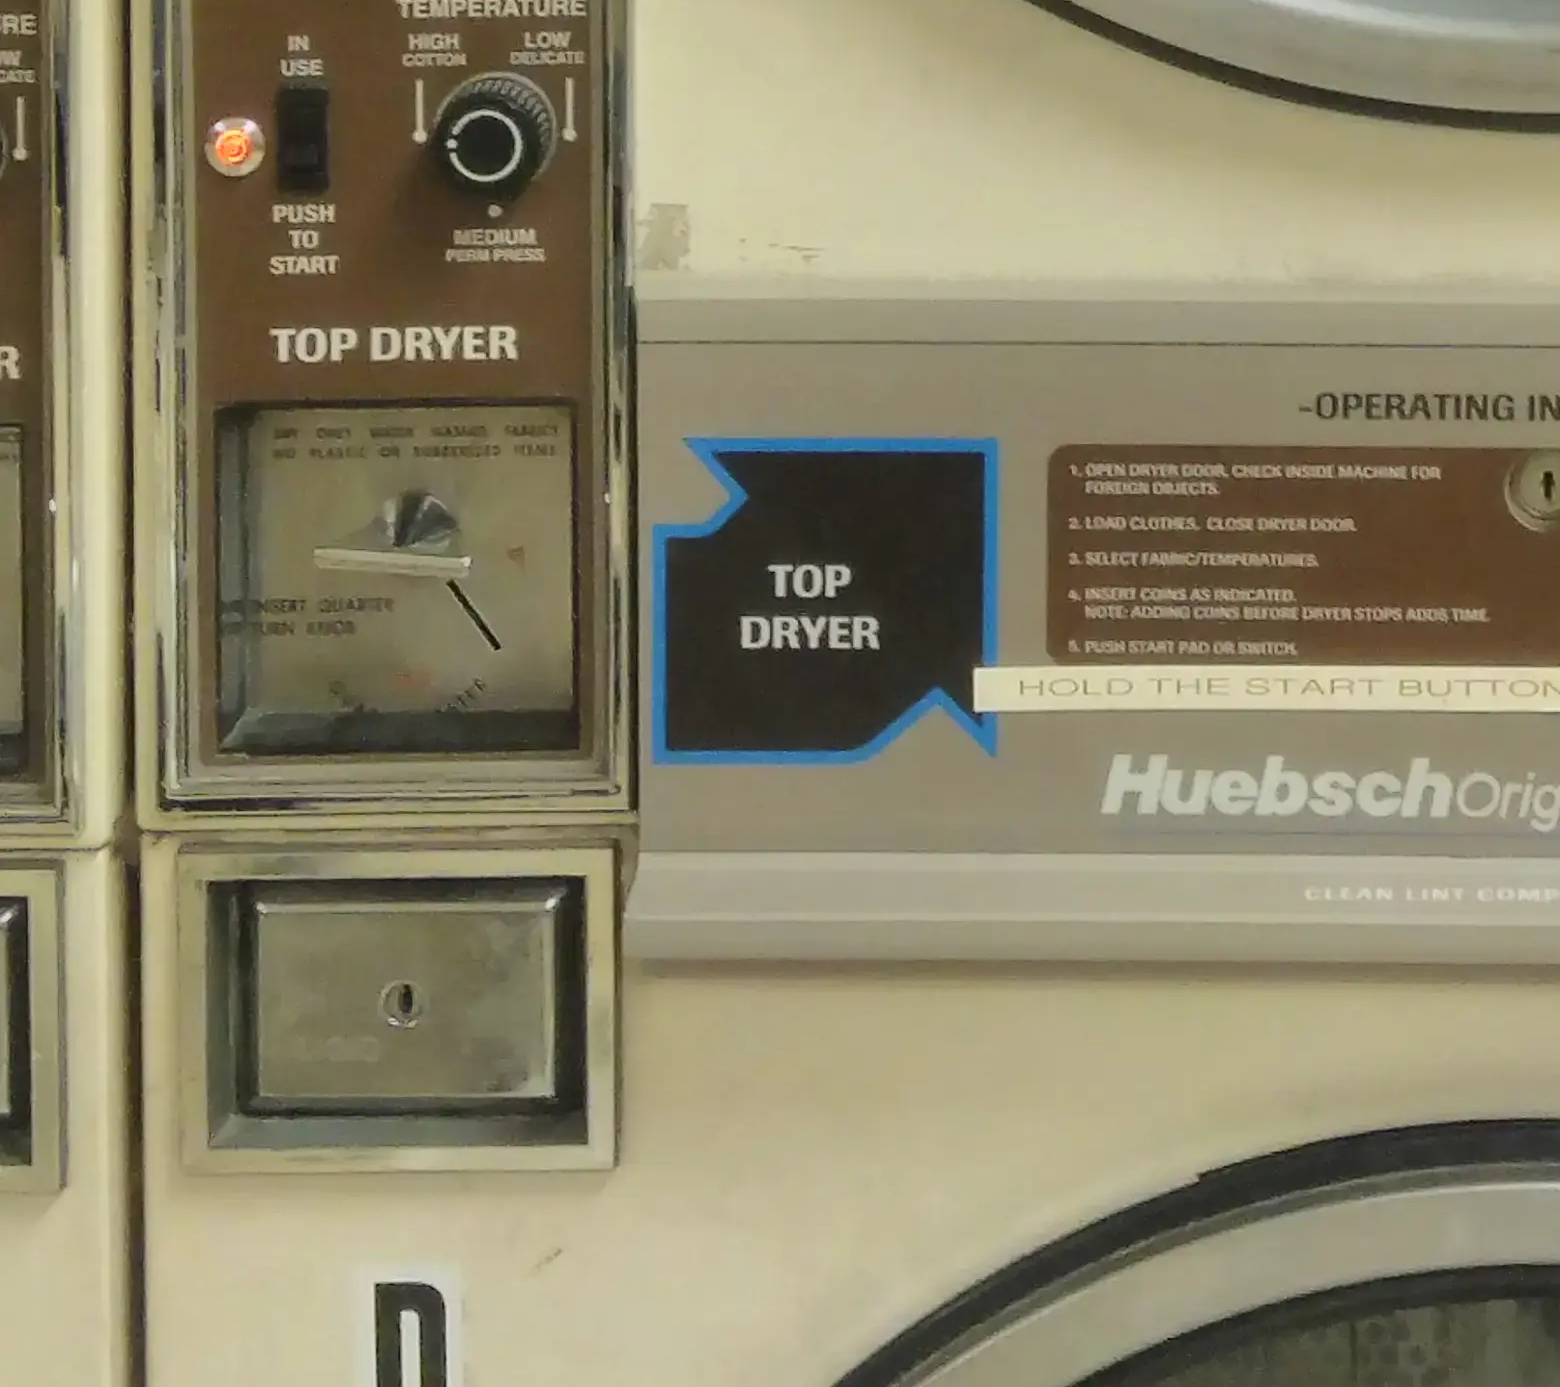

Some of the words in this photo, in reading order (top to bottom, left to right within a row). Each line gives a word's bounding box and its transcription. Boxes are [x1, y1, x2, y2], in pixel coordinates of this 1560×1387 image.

[287, 35, 310, 52] IN
[408, 33, 460, 52] HIGH
[523, 31, 571, 49] LOW
[402, 52, 467, 67] COTTON
[509, 50, 586, 65] DELICATE
[280, 58, 324, 77] USE
[271, 203, 336, 224] PUSH
[289, 230, 318, 250] TO
[453, 228, 537, 247] MEDIUM
[269, 254, 340, 275] START
[445, 247, 489, 262] PERM
[493, 247, 546, 263] PRESS
[270, 327, 358, 364] TOP
[370, 325, 518, 362] DRYER
[767, 564, 852, 598] TOP
[740, 615, 880, 650] DRYER
[1019, 678, 1134, 696] HOLD
[1151, 679, 1229, 697] THE
[1245, 680, 1383, 698] START
[1100, 753, 1454, 818] Huebsch
[1304, 886, 1394, 901] CLEAN
[1405, 887, 1465, 902] LINT
